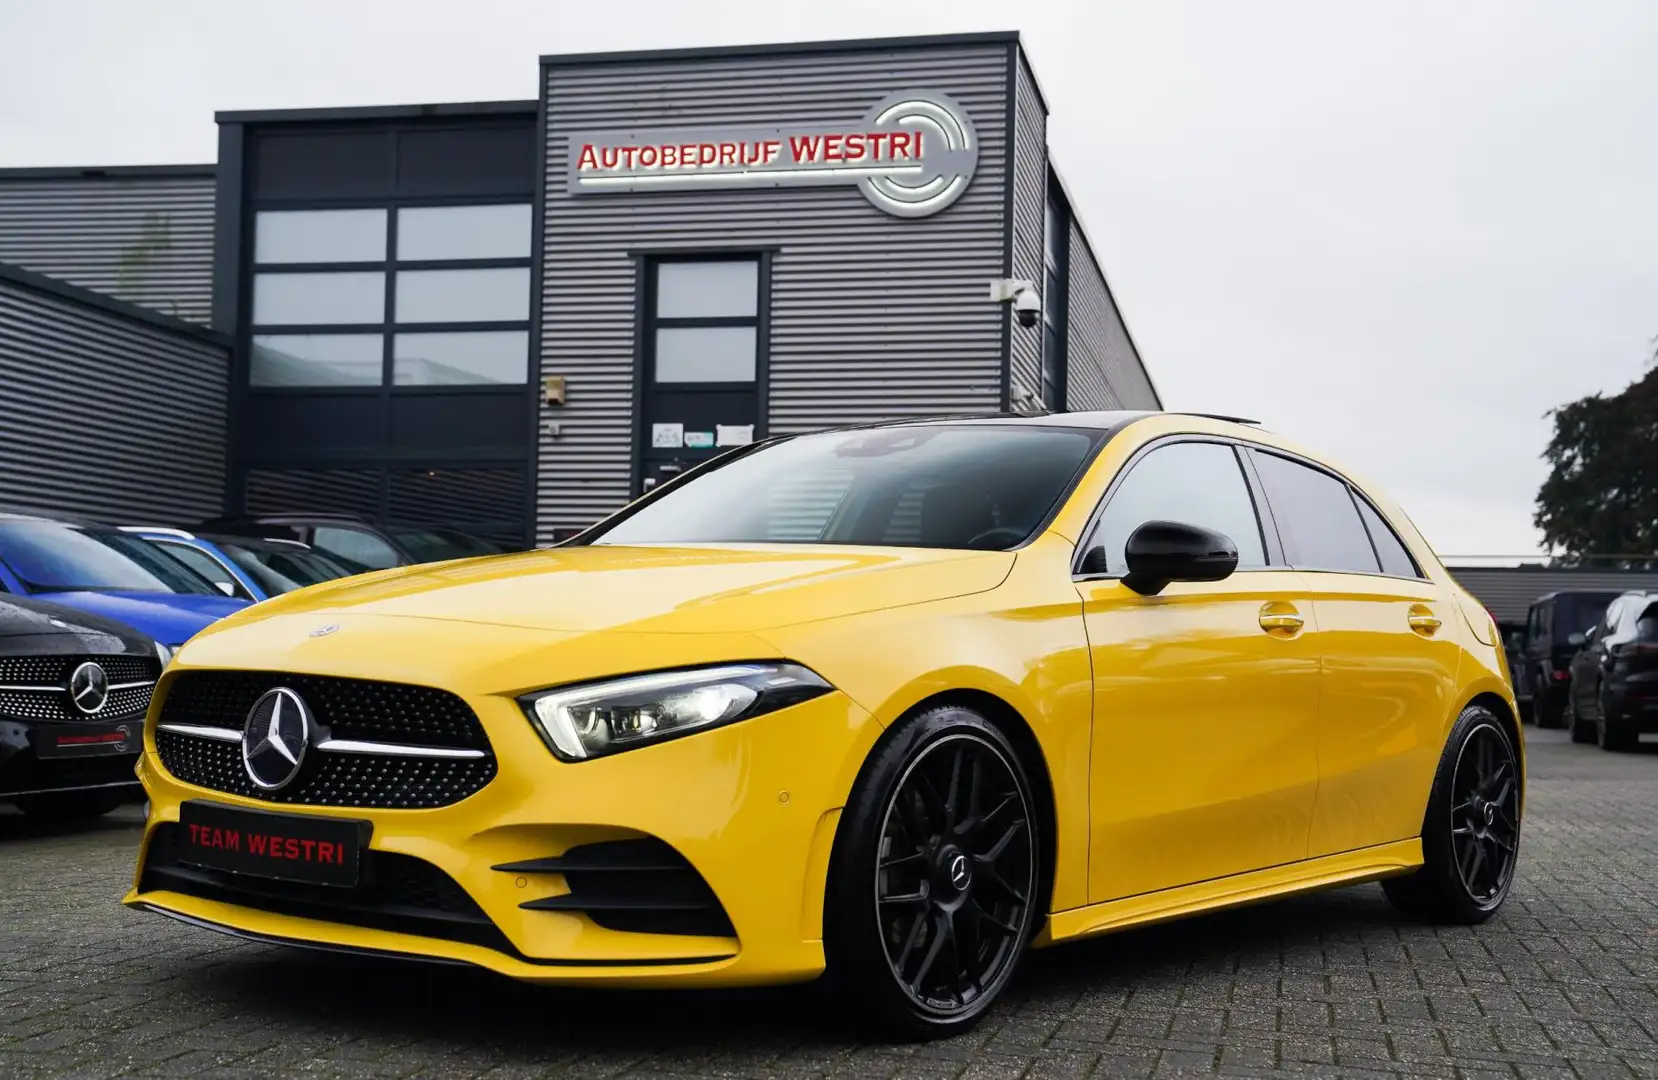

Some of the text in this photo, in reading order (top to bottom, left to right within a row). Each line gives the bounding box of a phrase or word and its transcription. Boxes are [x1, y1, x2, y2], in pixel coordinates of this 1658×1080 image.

[577, 131, 923, 170] AUTOBEDRIJF WESTRI
[190, 824, 344, 866] TEAM WESTRI
